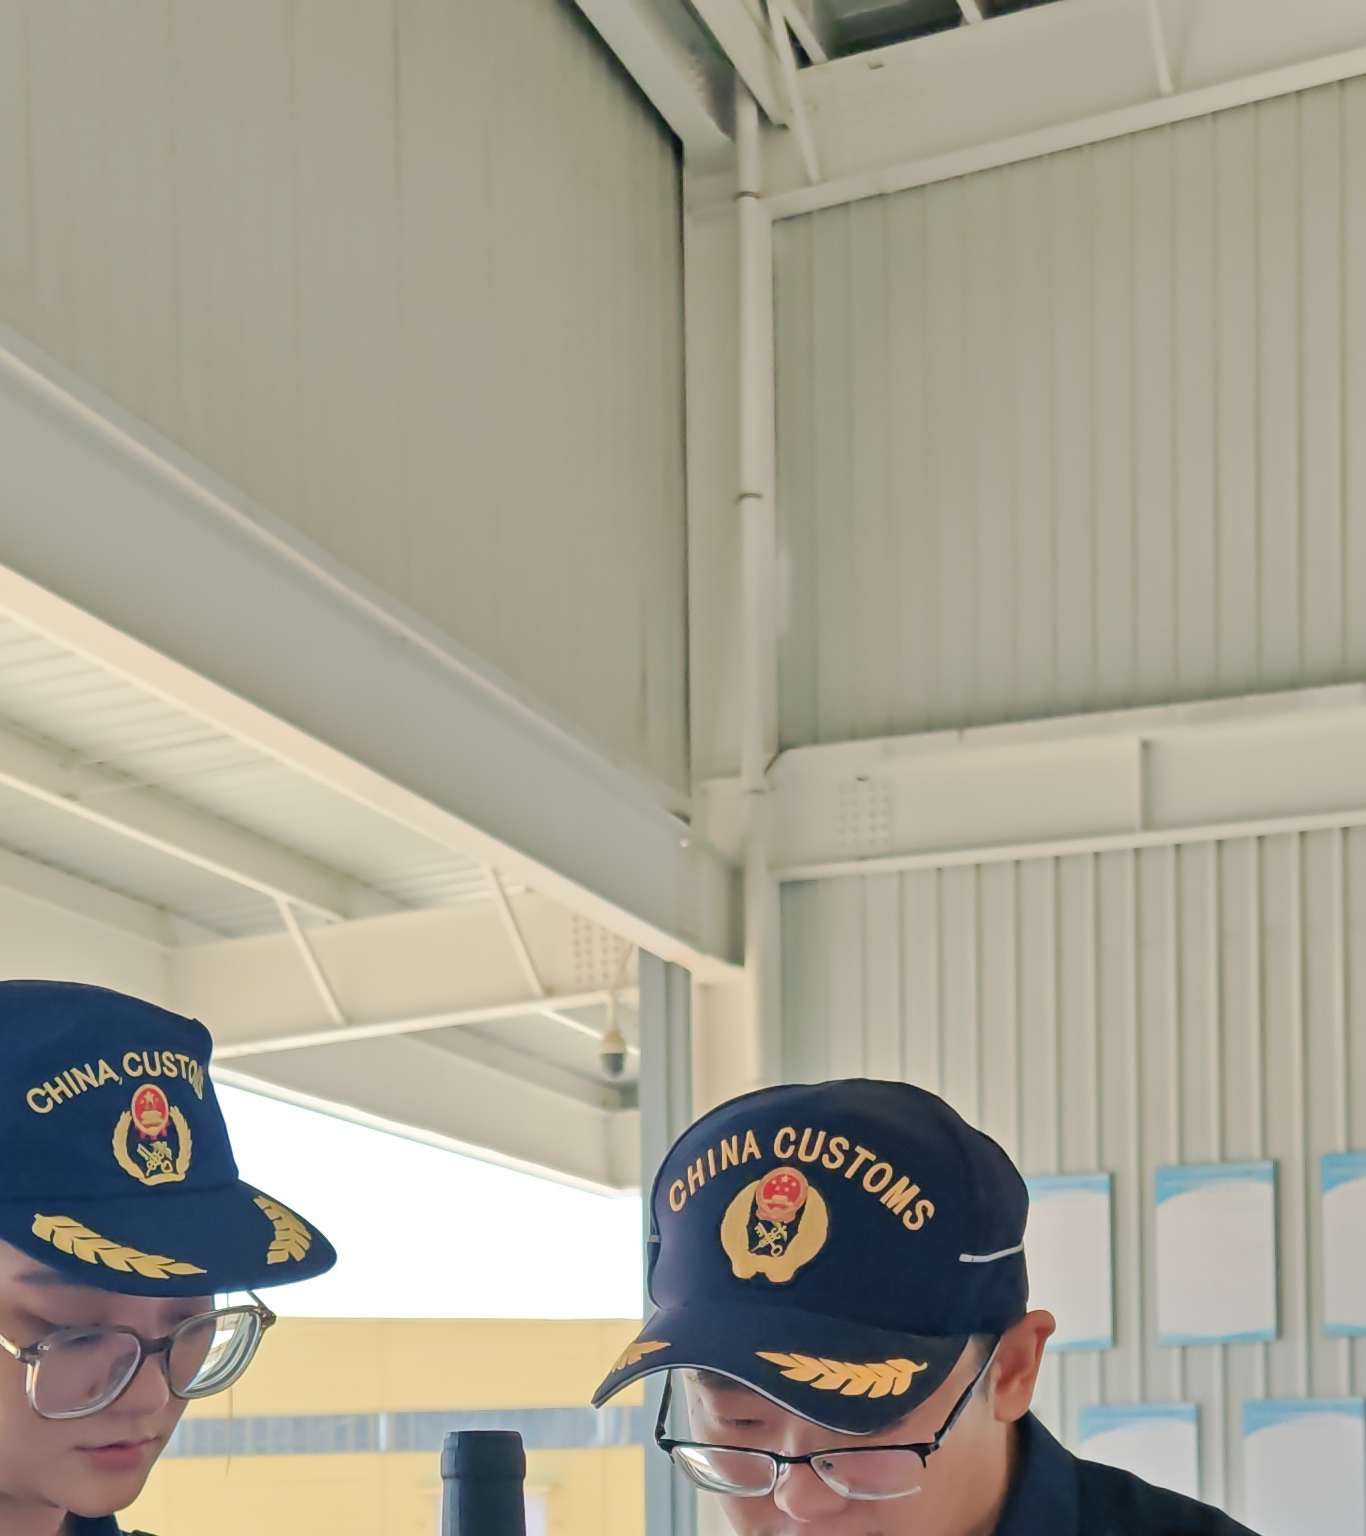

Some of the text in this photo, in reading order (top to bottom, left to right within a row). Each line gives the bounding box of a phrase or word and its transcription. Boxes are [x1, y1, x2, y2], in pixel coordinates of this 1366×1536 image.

[26, 1058, 120, 1114] CHINA
[669, 1126, 935, 1232] CHINA CUSTOMS
